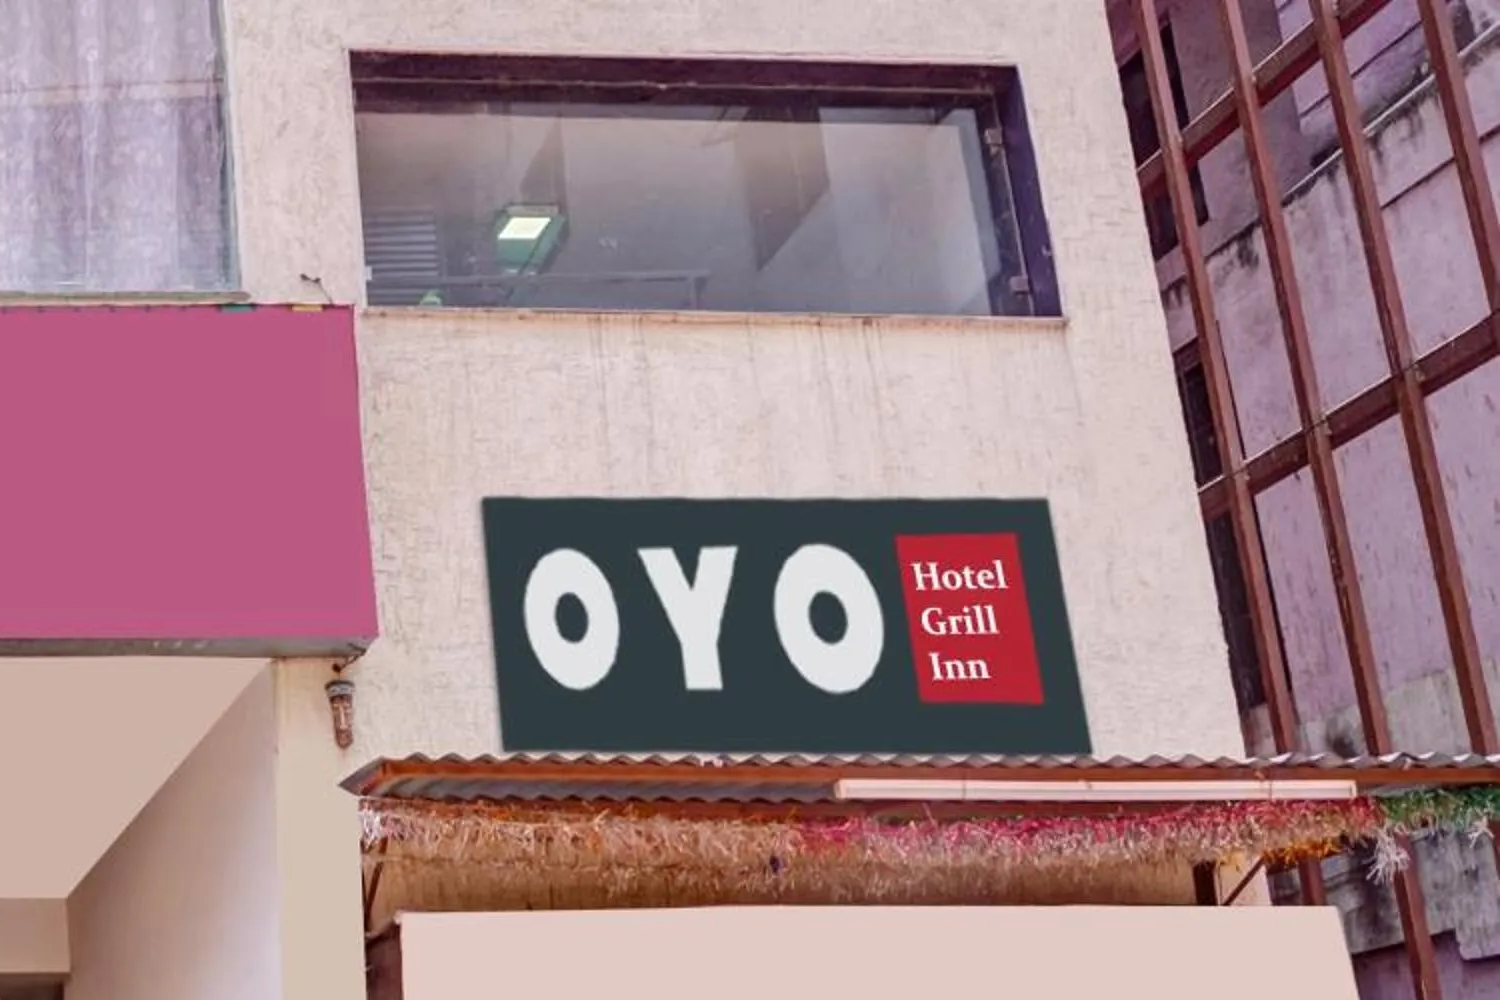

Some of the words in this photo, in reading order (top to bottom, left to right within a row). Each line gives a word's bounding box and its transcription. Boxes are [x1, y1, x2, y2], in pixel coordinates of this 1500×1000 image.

[911, 559, 1009, 591] Hotel
[523, 543, 885, 694] OYO
[920, 604, 999, 636] Grill
[928, 652, 991, 681] Inn
